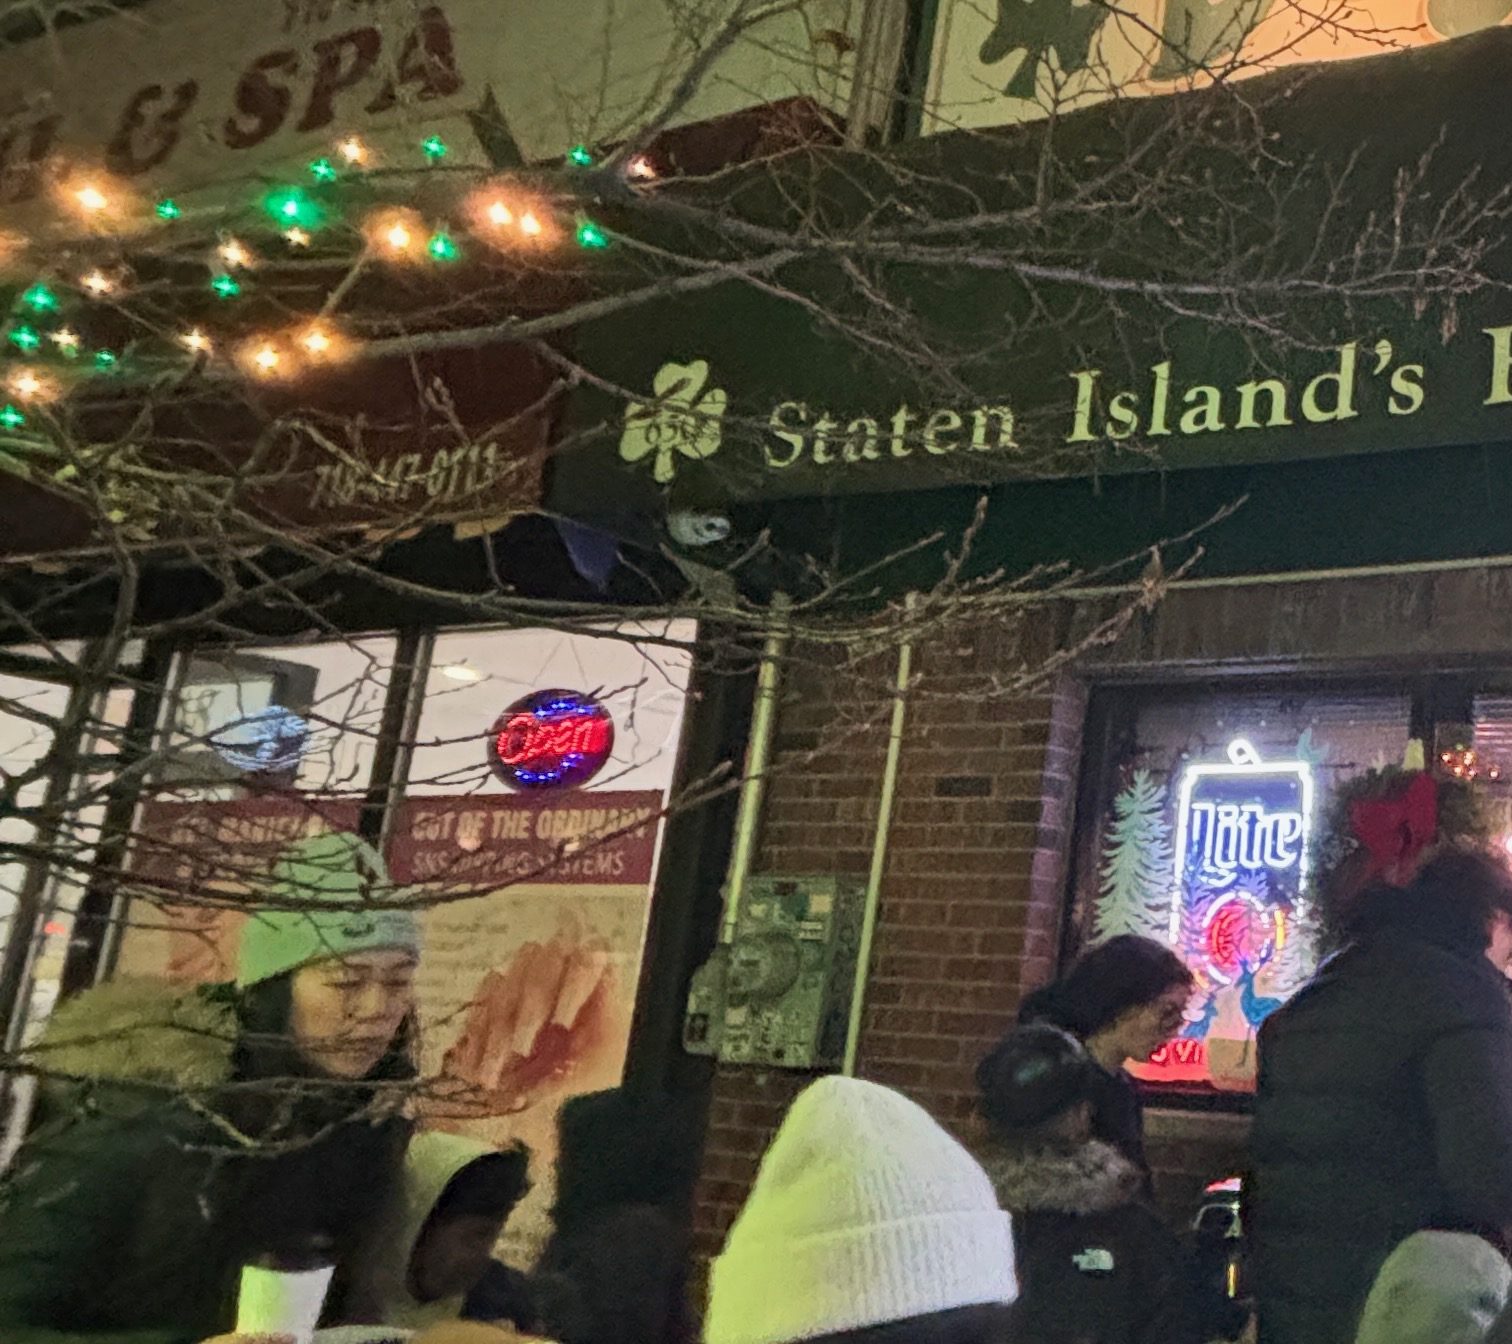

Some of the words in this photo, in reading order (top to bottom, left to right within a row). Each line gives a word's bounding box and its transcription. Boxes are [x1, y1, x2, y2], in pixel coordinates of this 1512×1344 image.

[223, 6, 463, 150] SPA
[765, 400, 1016, 468] Staten
[1065, 337, 1425, 445] Island's
[493, 810, 532, 839] THE
